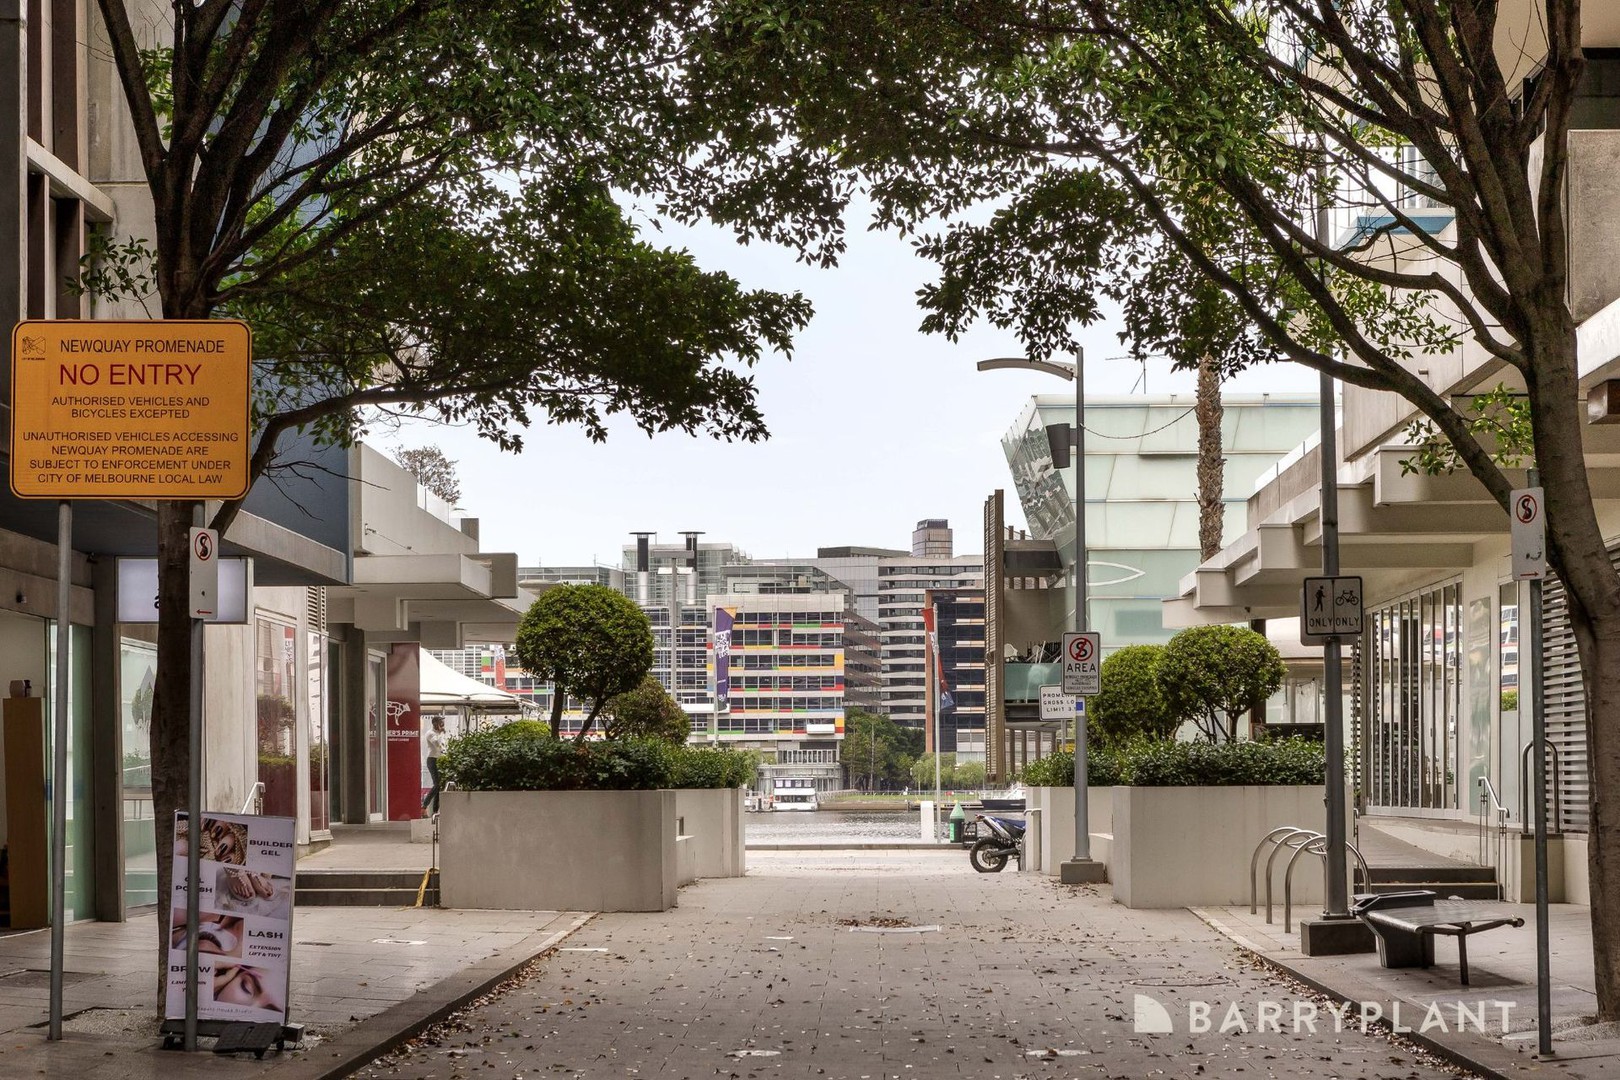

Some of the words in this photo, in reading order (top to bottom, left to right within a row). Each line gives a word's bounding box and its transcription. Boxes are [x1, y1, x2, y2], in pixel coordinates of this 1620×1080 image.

[60, 340, 131, 353] NEWQUAY
[135, 340, 225, 353] PROMENADE
[60, 364, 100, 386] NO
[110, 364, 202, 386] ENTRY
[52, 396, 125, 406] AUTHORISED
[128, 396, 184, 406] VEHICLES
[186, 396, 210, 406] AND
[72, 409, 126, 418] BICYCLES
[130, 409, 190, 418] EXCEPTED
[22, 432, 112, 442] UNAUTHORISED
[115, 432, 170, 442] VEHICLES
[172, 432, 238, 442] ACCESSING
[52, 446, 108, 456] NEWQUAY
[112, 446, 184, 456] PROMENADE
[186, 446, 209, 456] ARE
[30, 460, 80, 470] SUBJECT
[84, 460, 99, 470] TO
[102, 460, 188, 470] ENFORCEMENT
[192, 460, 230, 470] UNDER
[38, 474, 62, 483] CITY
[66, 474, 82, 483] OF
[85, 474, 155, 484] MELBOURNE
[158, 474, 194, 484] LOCAL
[198, 474, 223, 484] LAW
[1309, 617, 1332, 627] ONLY
[1336, 616, 1360, 626] ONLY
[1066, 663, 1096, 672] AREA
[250, 840, 292, 848] BUILDER
[176, 885, 212, 893] POSH
[248, 930, 283, 939] LASH
